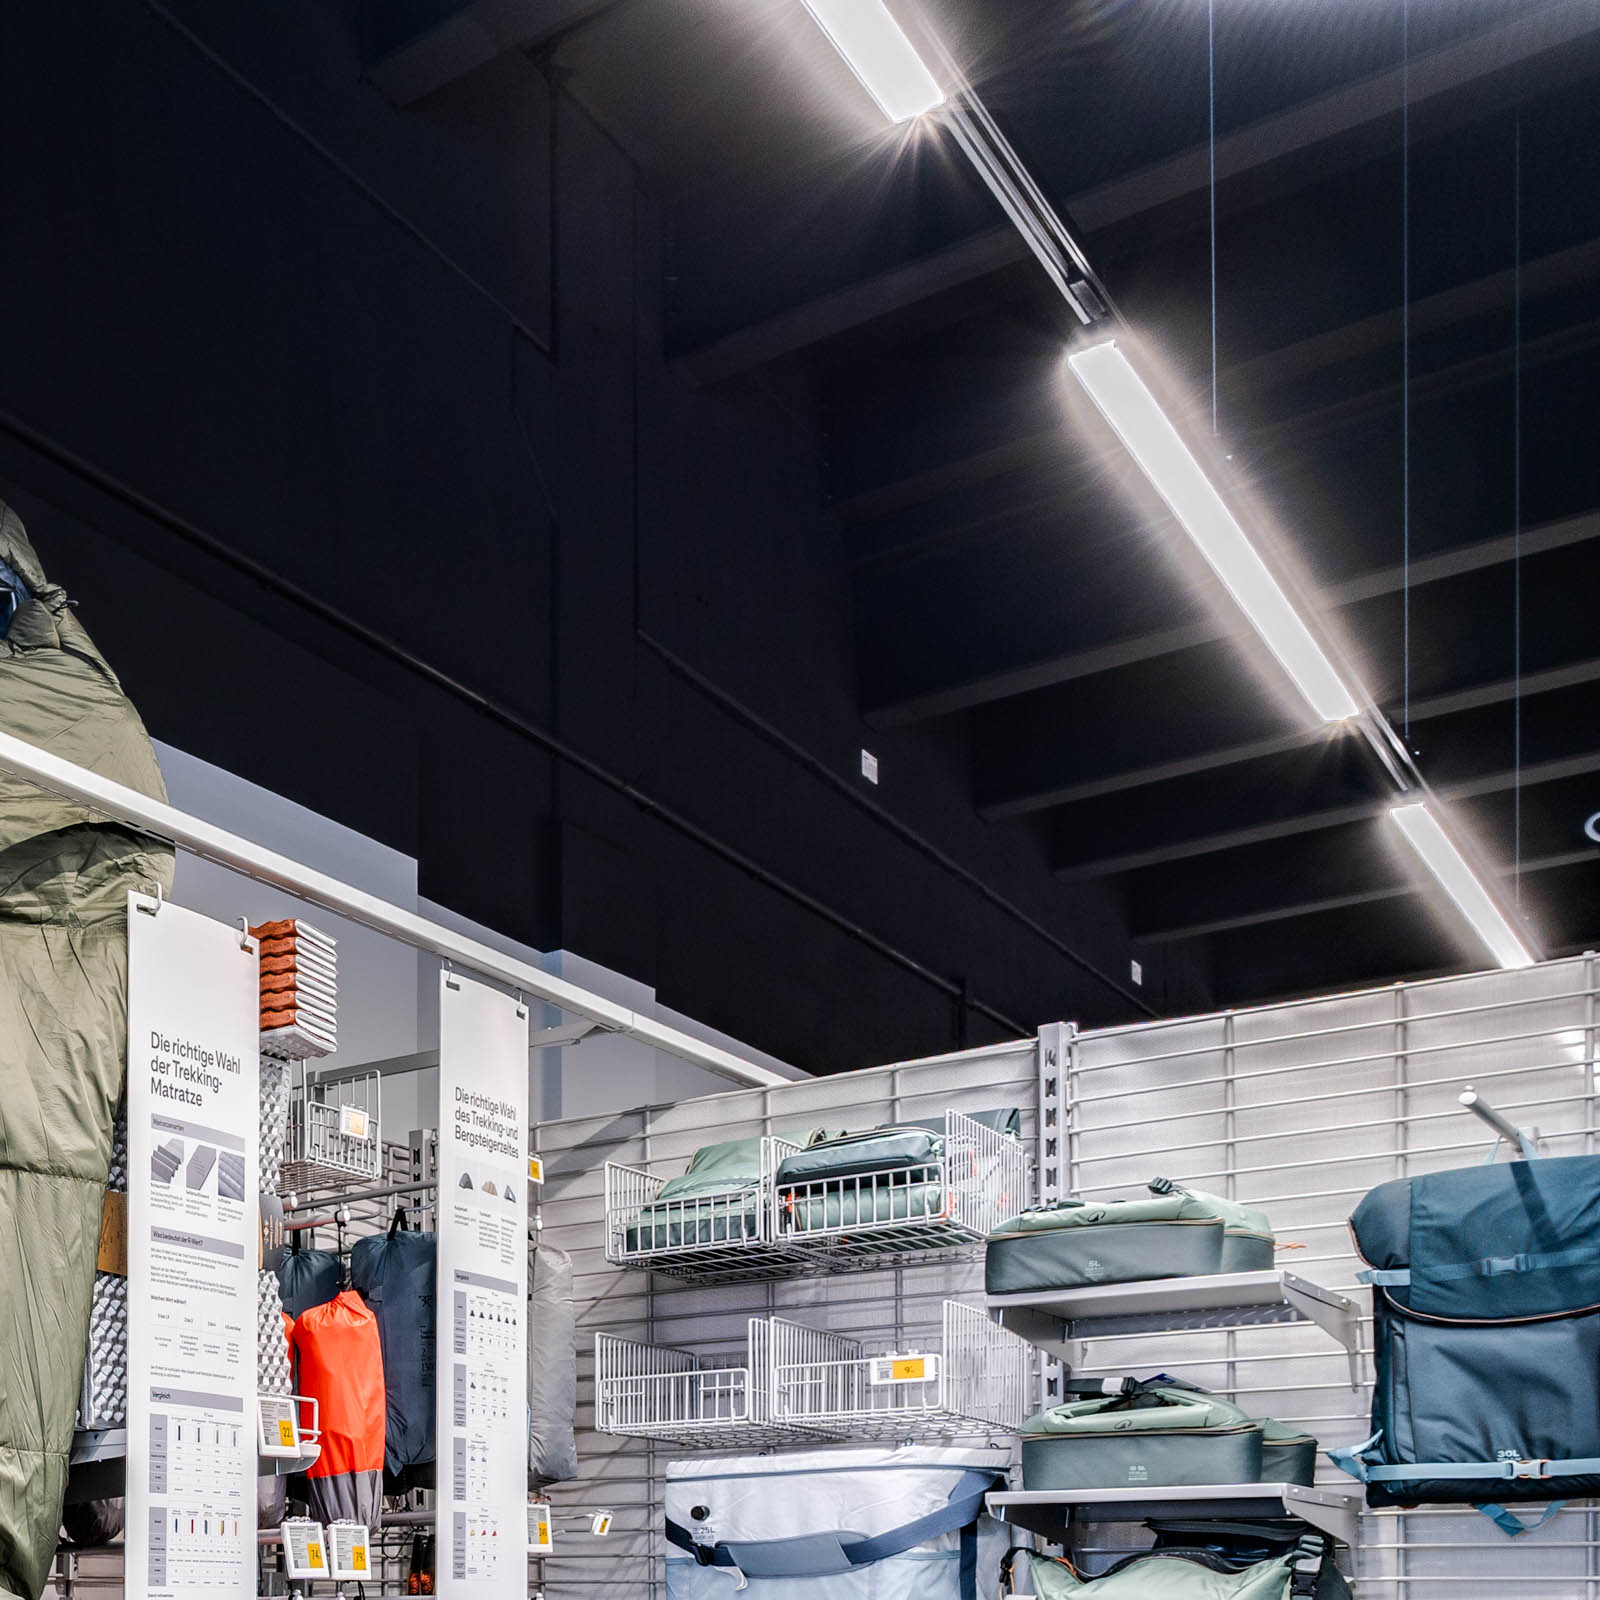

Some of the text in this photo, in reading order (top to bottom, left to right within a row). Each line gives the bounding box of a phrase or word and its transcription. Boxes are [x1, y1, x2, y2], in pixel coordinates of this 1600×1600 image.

[151, 1031, 240, 1074] Die richtige Wahl
[151, 1056, 222, 1093] der Trekking-
[151, 1077, 202, 1106] Matratze
[455, 1087, 516, 1121] Die richtige Wahl
[455, 1106, 470, 1123] des
[455, 1125, 519, 1158] Bergsteigerzeltes
